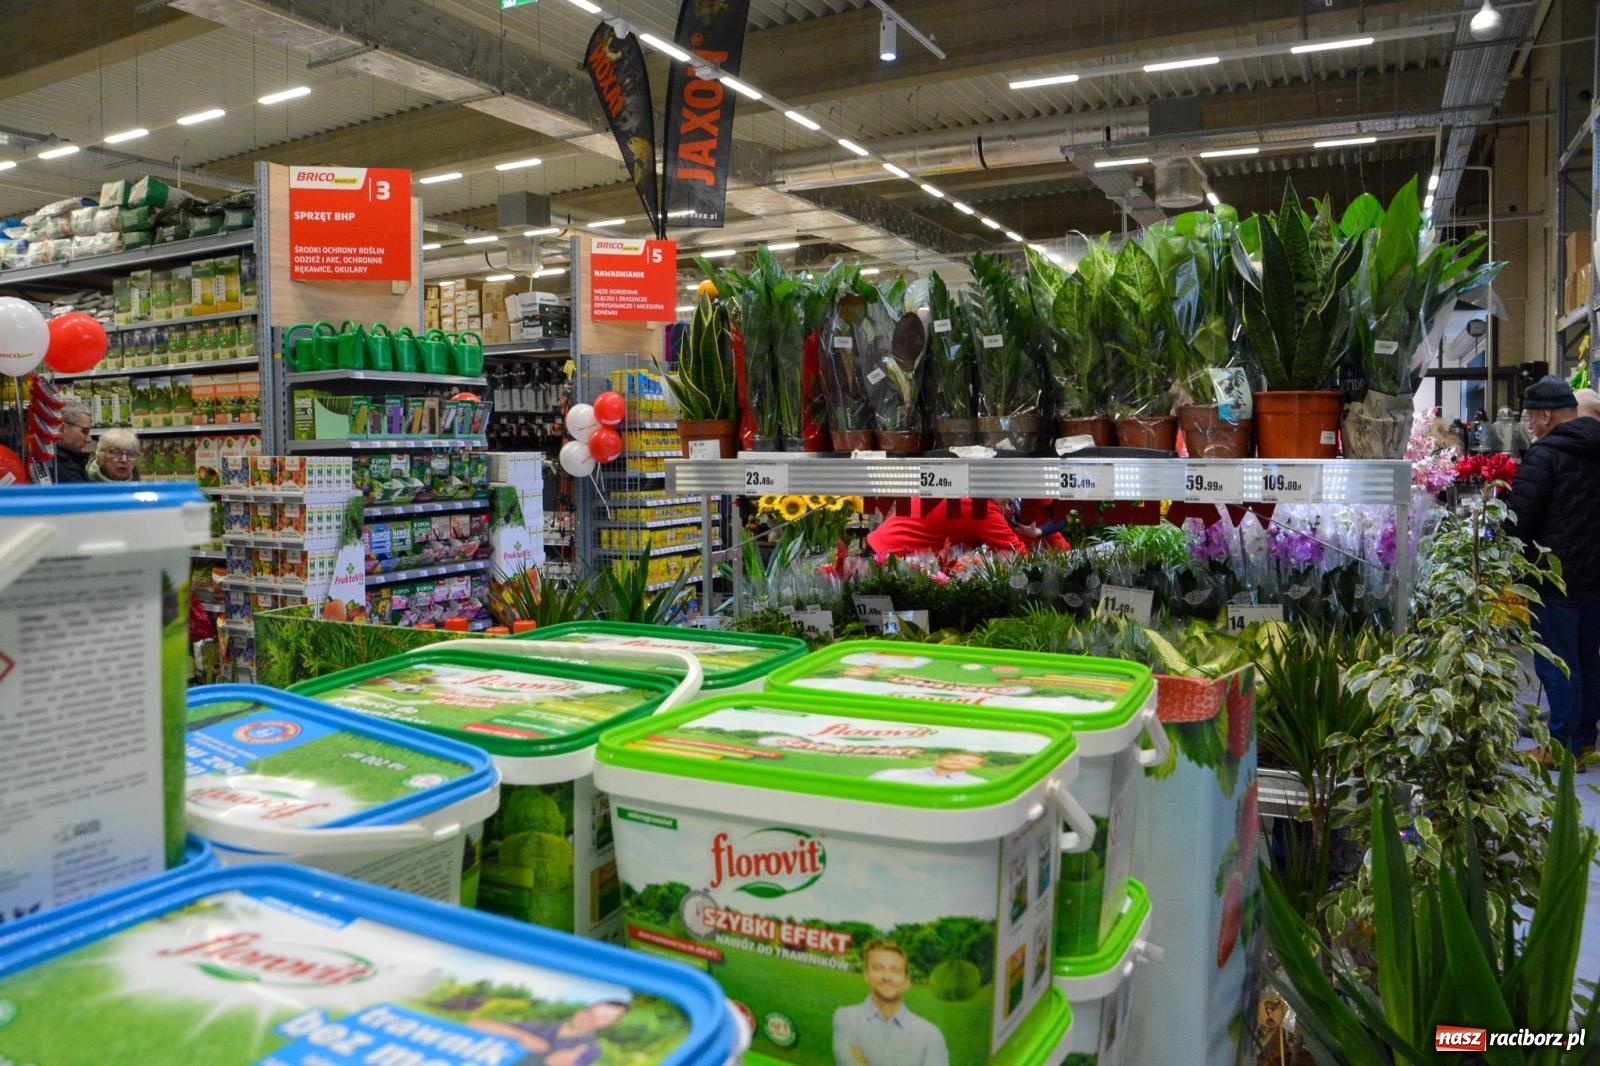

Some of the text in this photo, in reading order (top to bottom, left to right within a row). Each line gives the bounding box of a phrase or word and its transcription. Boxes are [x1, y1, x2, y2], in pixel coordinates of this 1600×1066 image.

[297, 171, 335, 182] BRICO
[376, 180, 391, 201] 3
[294, 211, 355, 222] SPRZĘT BHP
[294, 245, 384, 255] ŚRODKI OCHRONY ROŚLIN
[652, 248, 663, 264] 5
[294, 256, 321, 264] ODZIEŻ
[322, 256, 325, 264] I
[343, 257, 383, 265] OCHRONNE
[334, 266, 368, 274] OKULARY
[594, 270, 645, 279] NAWADNIANIE
[334, 572, 364, 585] FruktoVit
[710, 832, 822, 889] florovit
[703, 905, 852, 955] SZYBKI EFEKT
[716, 933, 756, 951] NAWÓZ
[756, 944, 773, 957] DO
[775, 946, 850, 972] TRAWNIKÓW
